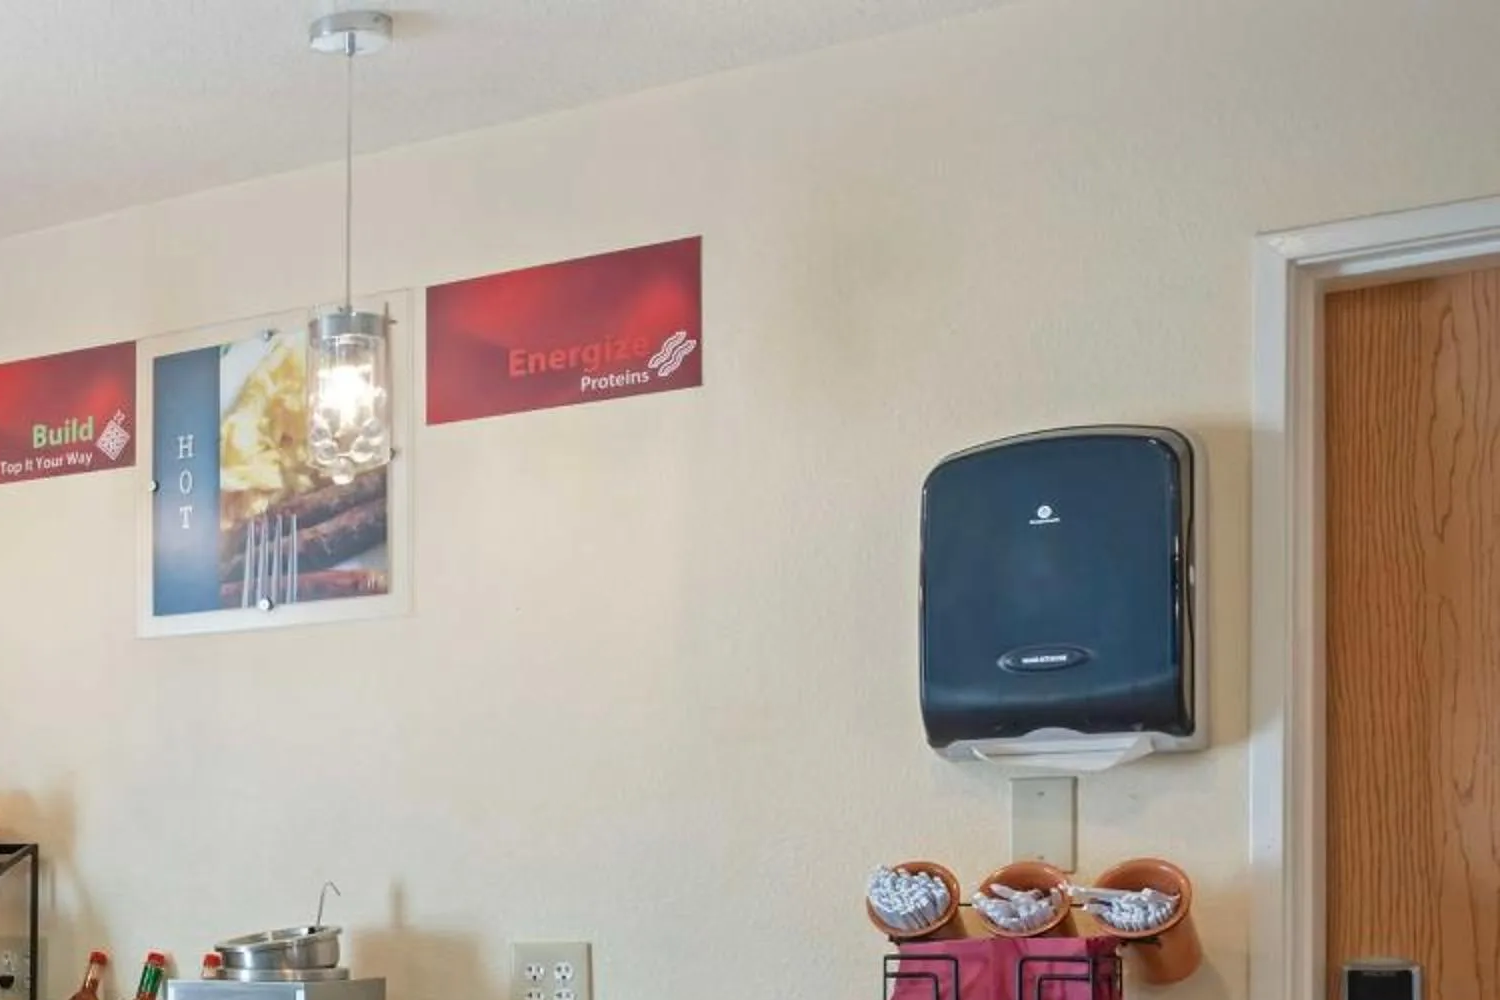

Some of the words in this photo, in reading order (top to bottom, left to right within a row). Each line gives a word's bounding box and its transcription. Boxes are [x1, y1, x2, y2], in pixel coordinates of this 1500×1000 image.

[507, 334, 648, 378] Energize
[580, 369, 650, 393] Proteins
[32, 415, 94, 449] Build
[0, 461, 23, 476] Top
[25, 459, 33, 471] It
[35, 456, 64, 470] Your
[66, 451, 93, 467] Way
[177, 433, 194, 529] HOT
